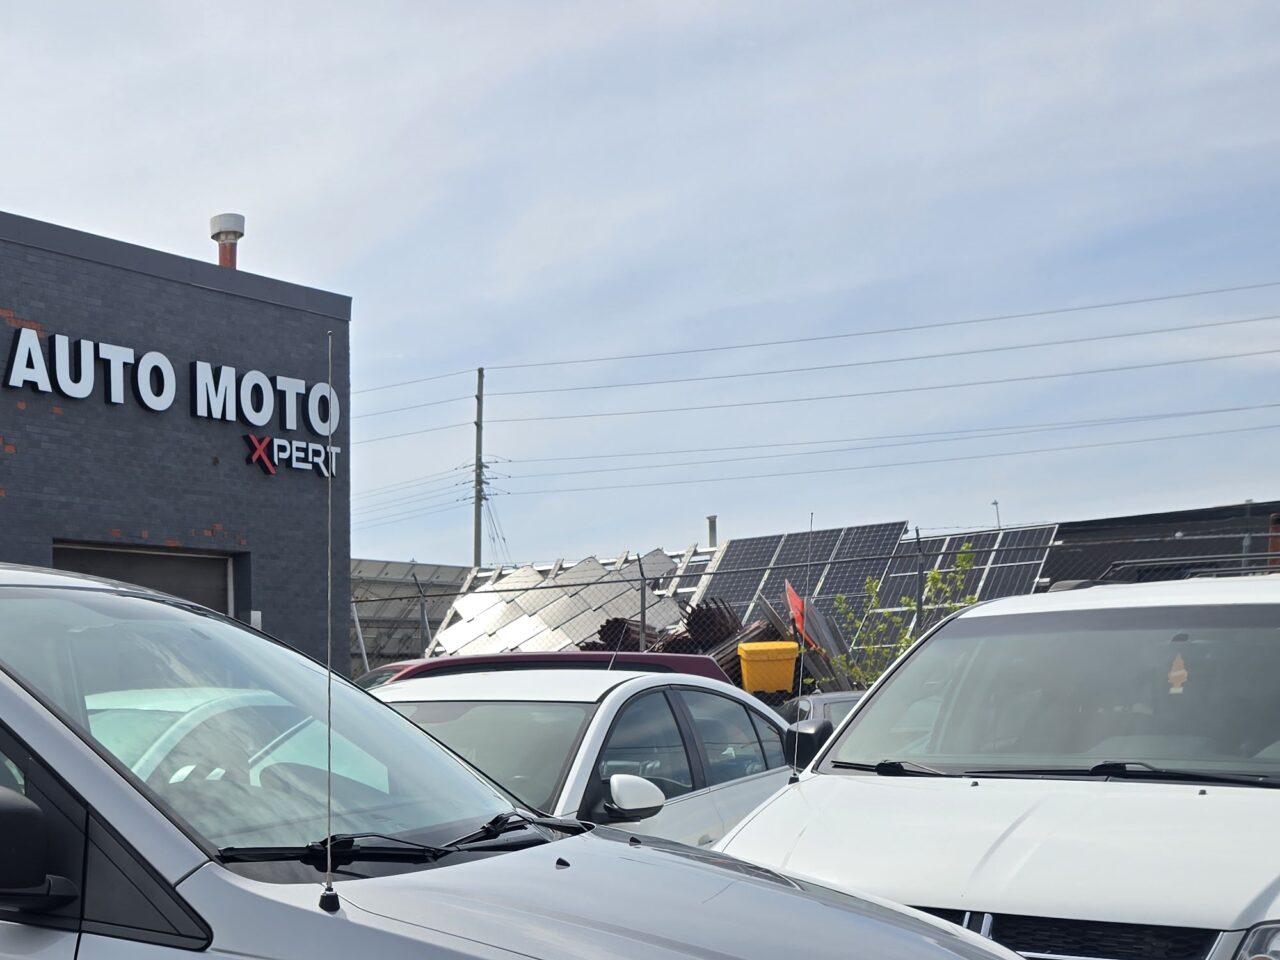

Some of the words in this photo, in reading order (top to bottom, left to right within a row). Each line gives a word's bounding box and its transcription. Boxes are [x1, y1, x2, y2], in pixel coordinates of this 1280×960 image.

[8, 327, 176, 411] AUTO
[195, 360, 340, 436] MOTO
[248, 433, 341, 478] XPERT
